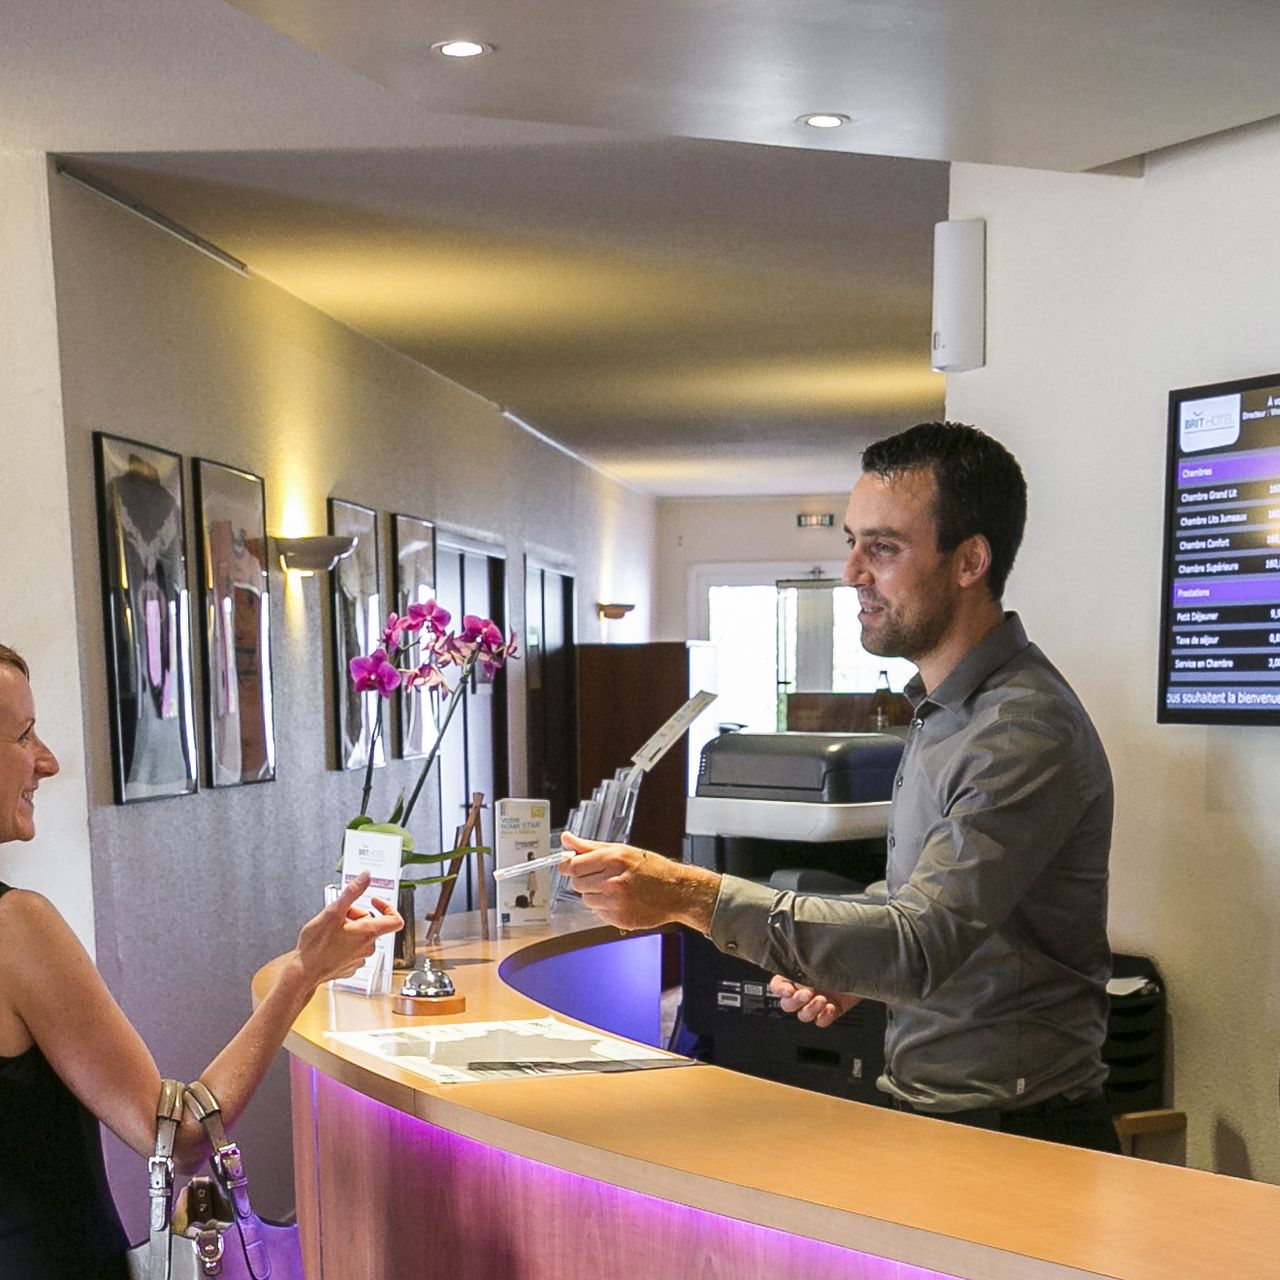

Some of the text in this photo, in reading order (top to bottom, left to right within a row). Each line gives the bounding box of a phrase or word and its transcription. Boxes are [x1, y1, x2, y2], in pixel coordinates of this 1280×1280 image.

[1184, 413, 1234, 430] BRIT HOTEL
[1182, 468, 1212, 478] Chambres
[1181, 488, 1238, 502] Chambre Grand Lit
[1180, 516, 1207, 527] Chambre
[1219, 513, 1248, 524] Jumeaux
[1179, 538, 1230, 550] Chambre Confort
[1178, 562, 1239, 574] Chambre Supérieure
[1177, 588, 1210, 598] Prestations
[1177, 611, 1219, 623] Petit Déjeuner
[1176, 635, 1219, 646] Taxe de séjour
[1175, 658, 1234, 669] Service en Chambre
[1182, 690, 1226, 704] souhaitent
[1227, 690, 1236, 704] la
